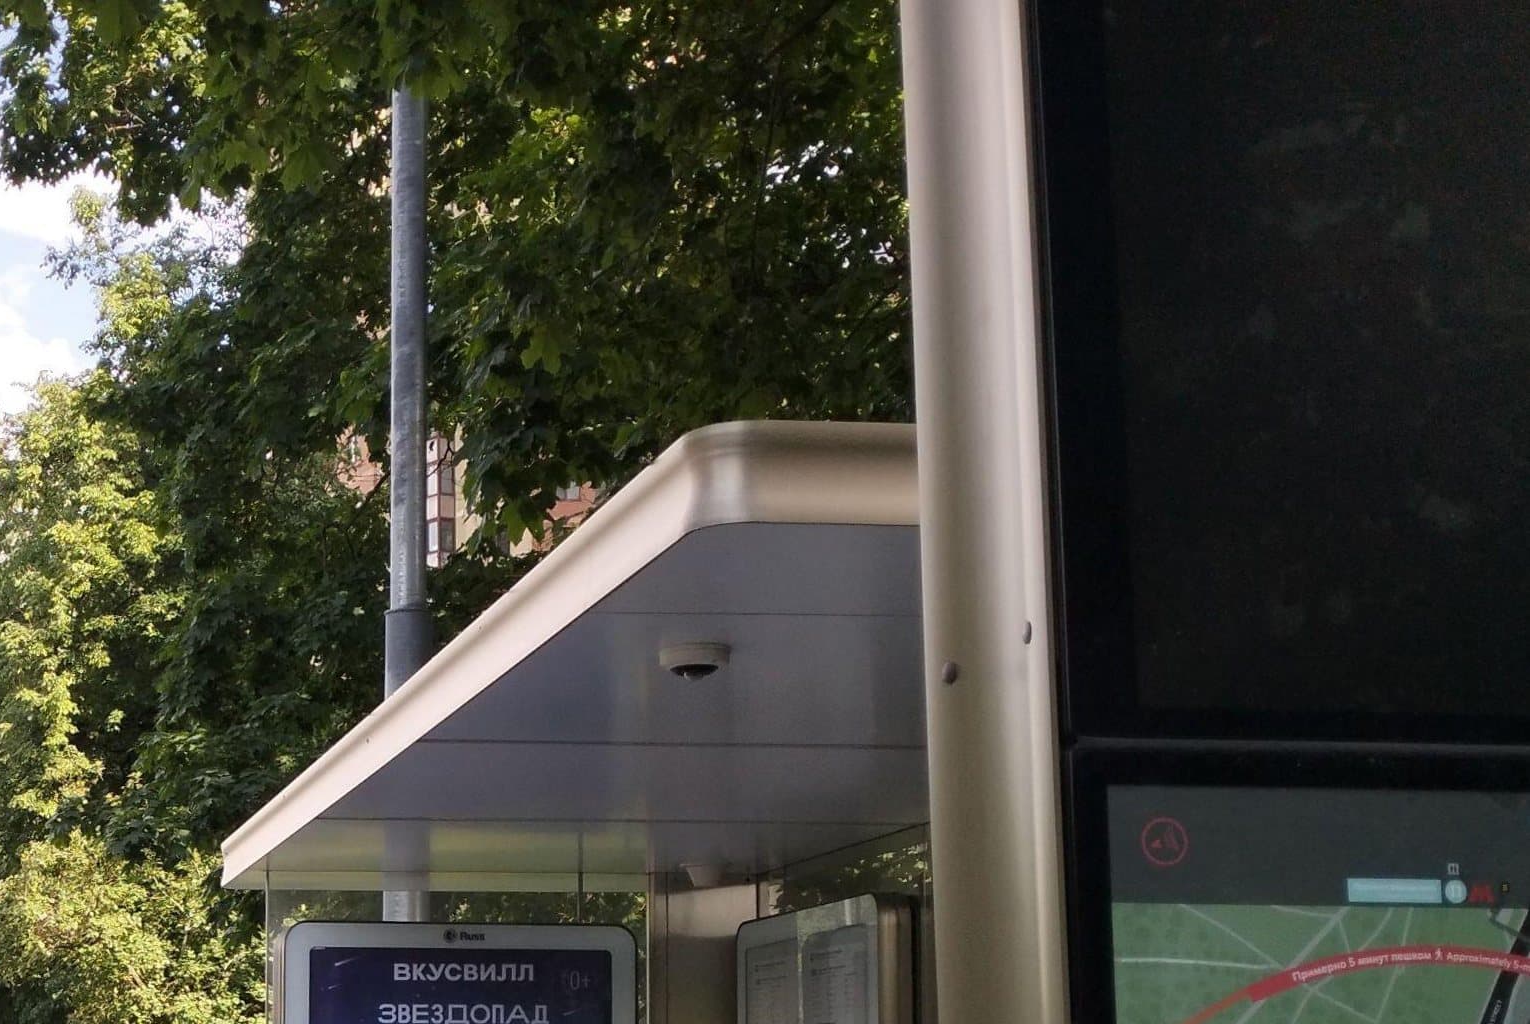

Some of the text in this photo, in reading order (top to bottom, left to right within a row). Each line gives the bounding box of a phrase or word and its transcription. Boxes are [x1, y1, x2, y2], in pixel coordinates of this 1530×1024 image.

[1291, 961, 1347, 983] Примерно
[1348, 956, 1356, 968] 5
[1390, 951, 1433, 962] пешком
[1445, 951, 1512, 968] Approximately
[393, 963, 535, 982] ВКУСВИЛЛ
